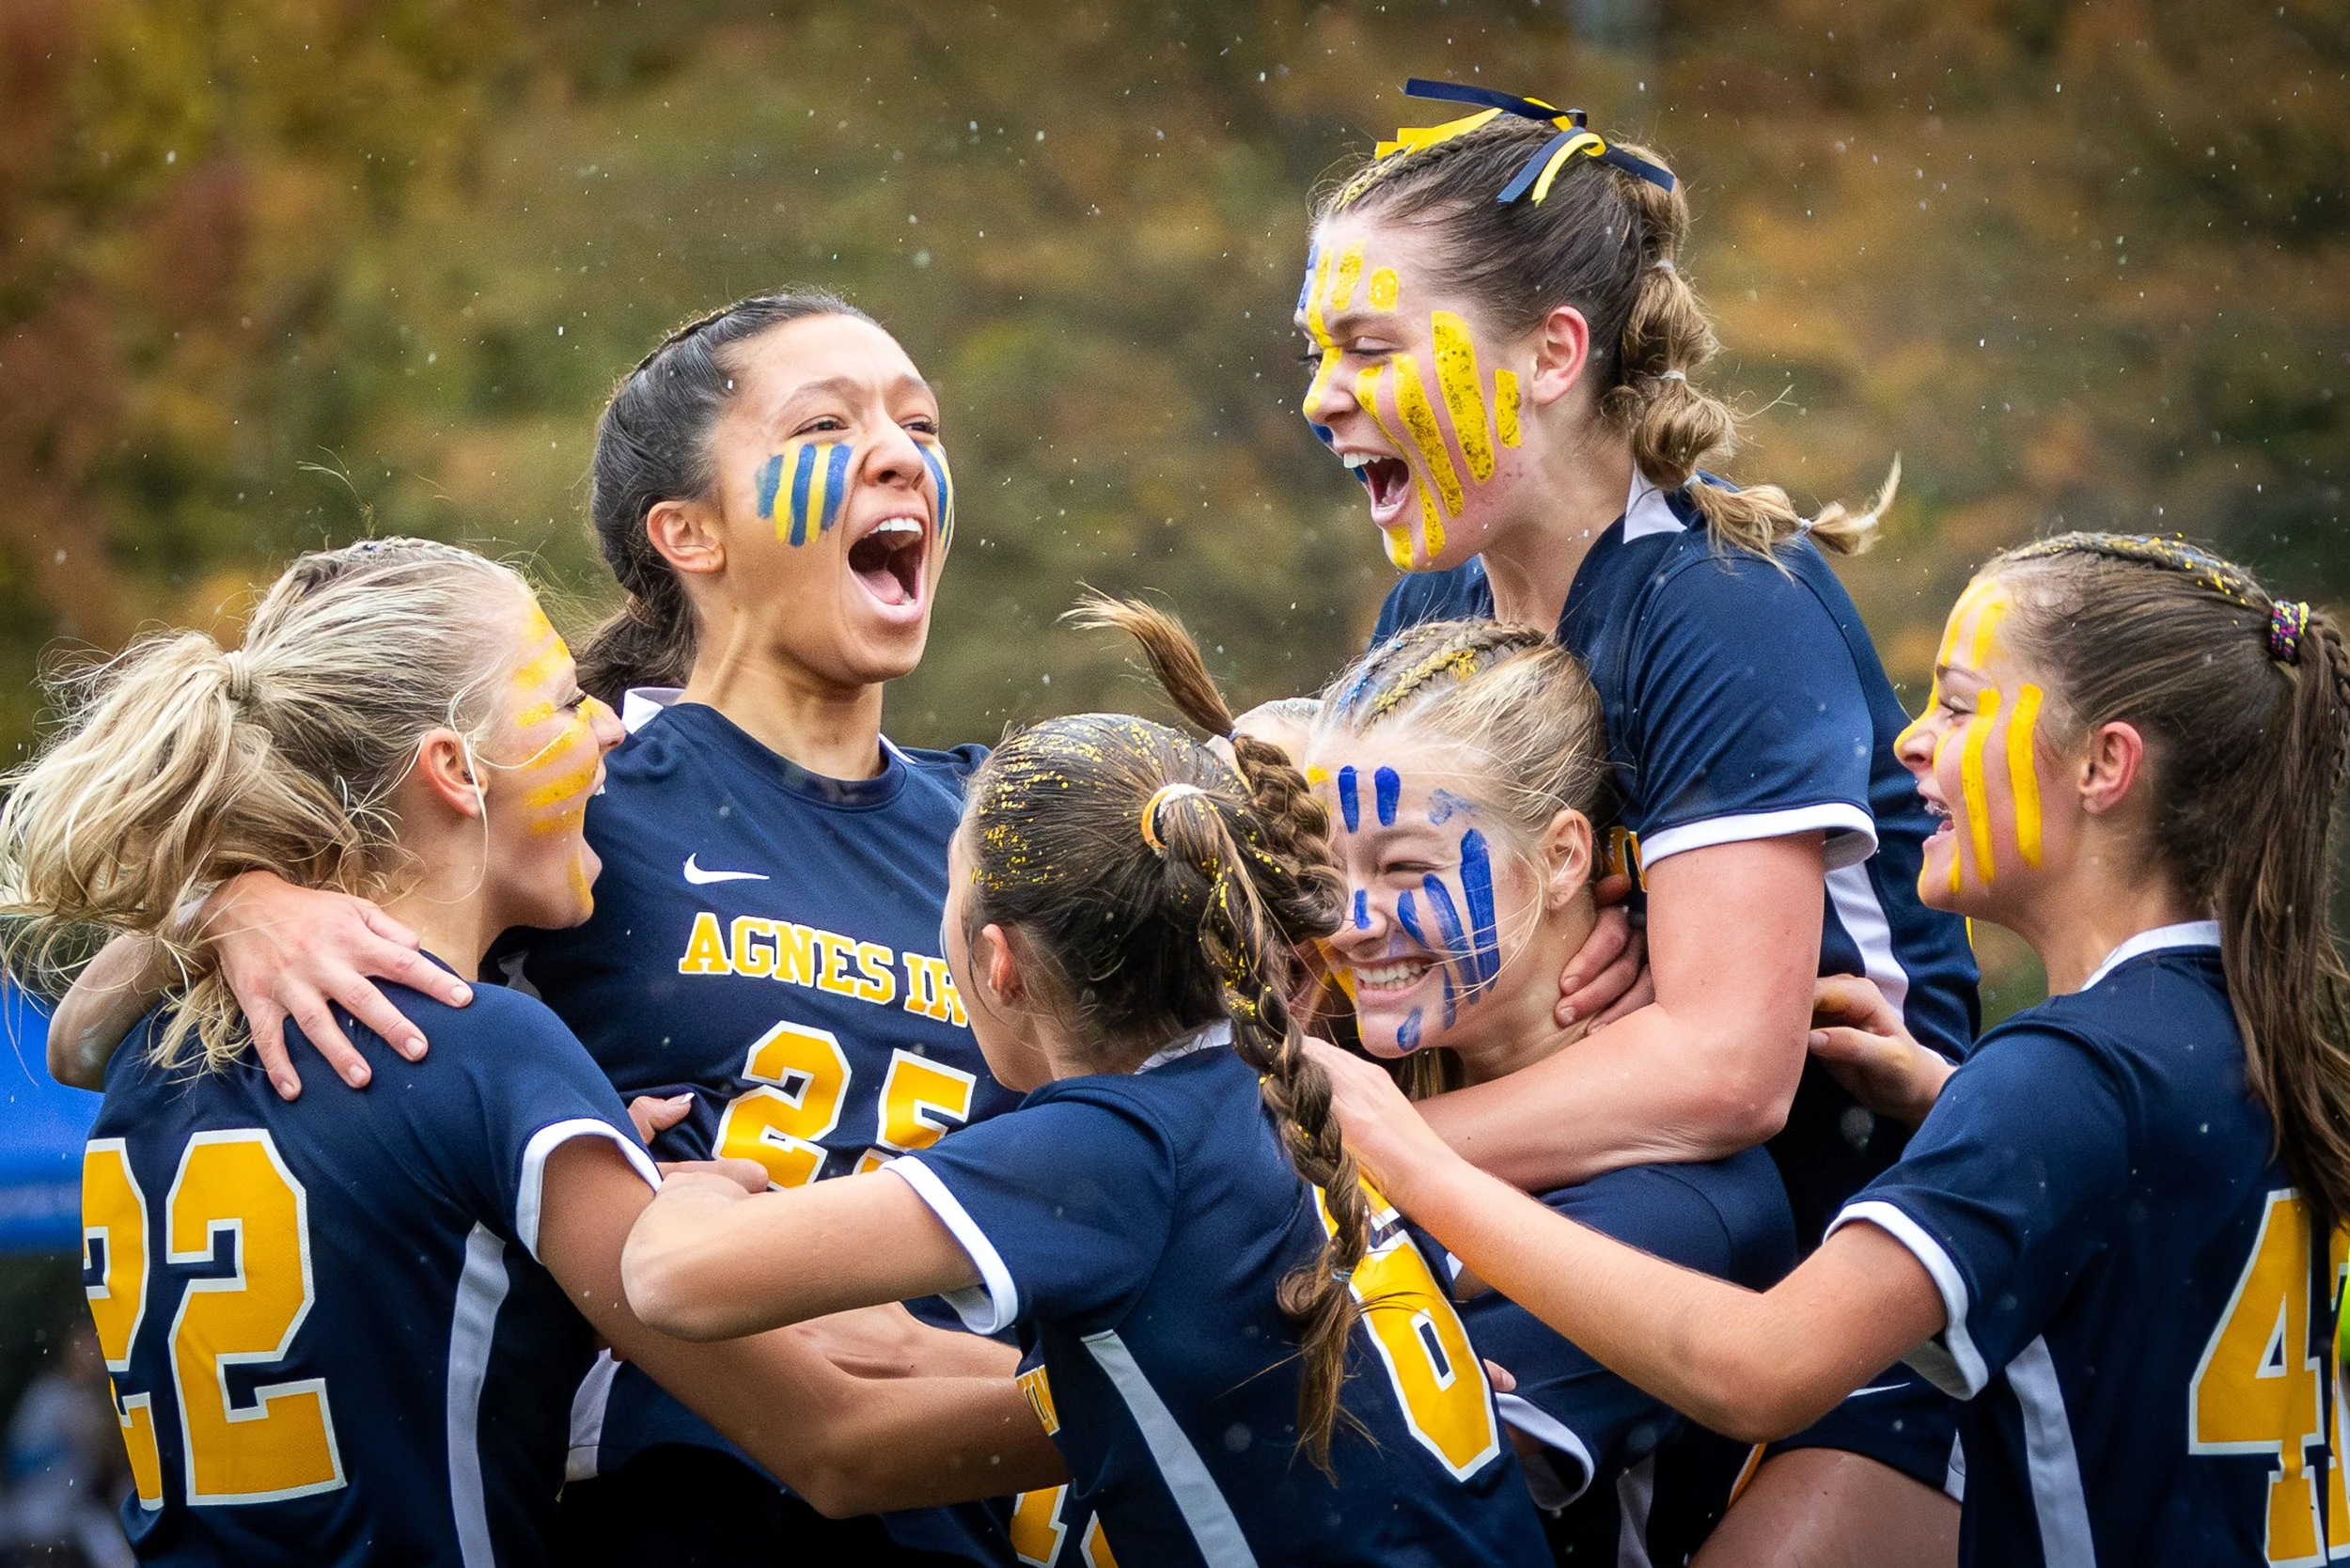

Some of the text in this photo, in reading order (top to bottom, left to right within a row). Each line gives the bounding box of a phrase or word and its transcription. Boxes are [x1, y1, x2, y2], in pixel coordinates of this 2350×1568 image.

[679, 911, 894, 1005] AGNES
[712, 1020, 977, 1191] 25
[82, 1128, 347, 1511] 22
[2188, 1187, 2350, 1567] 4
